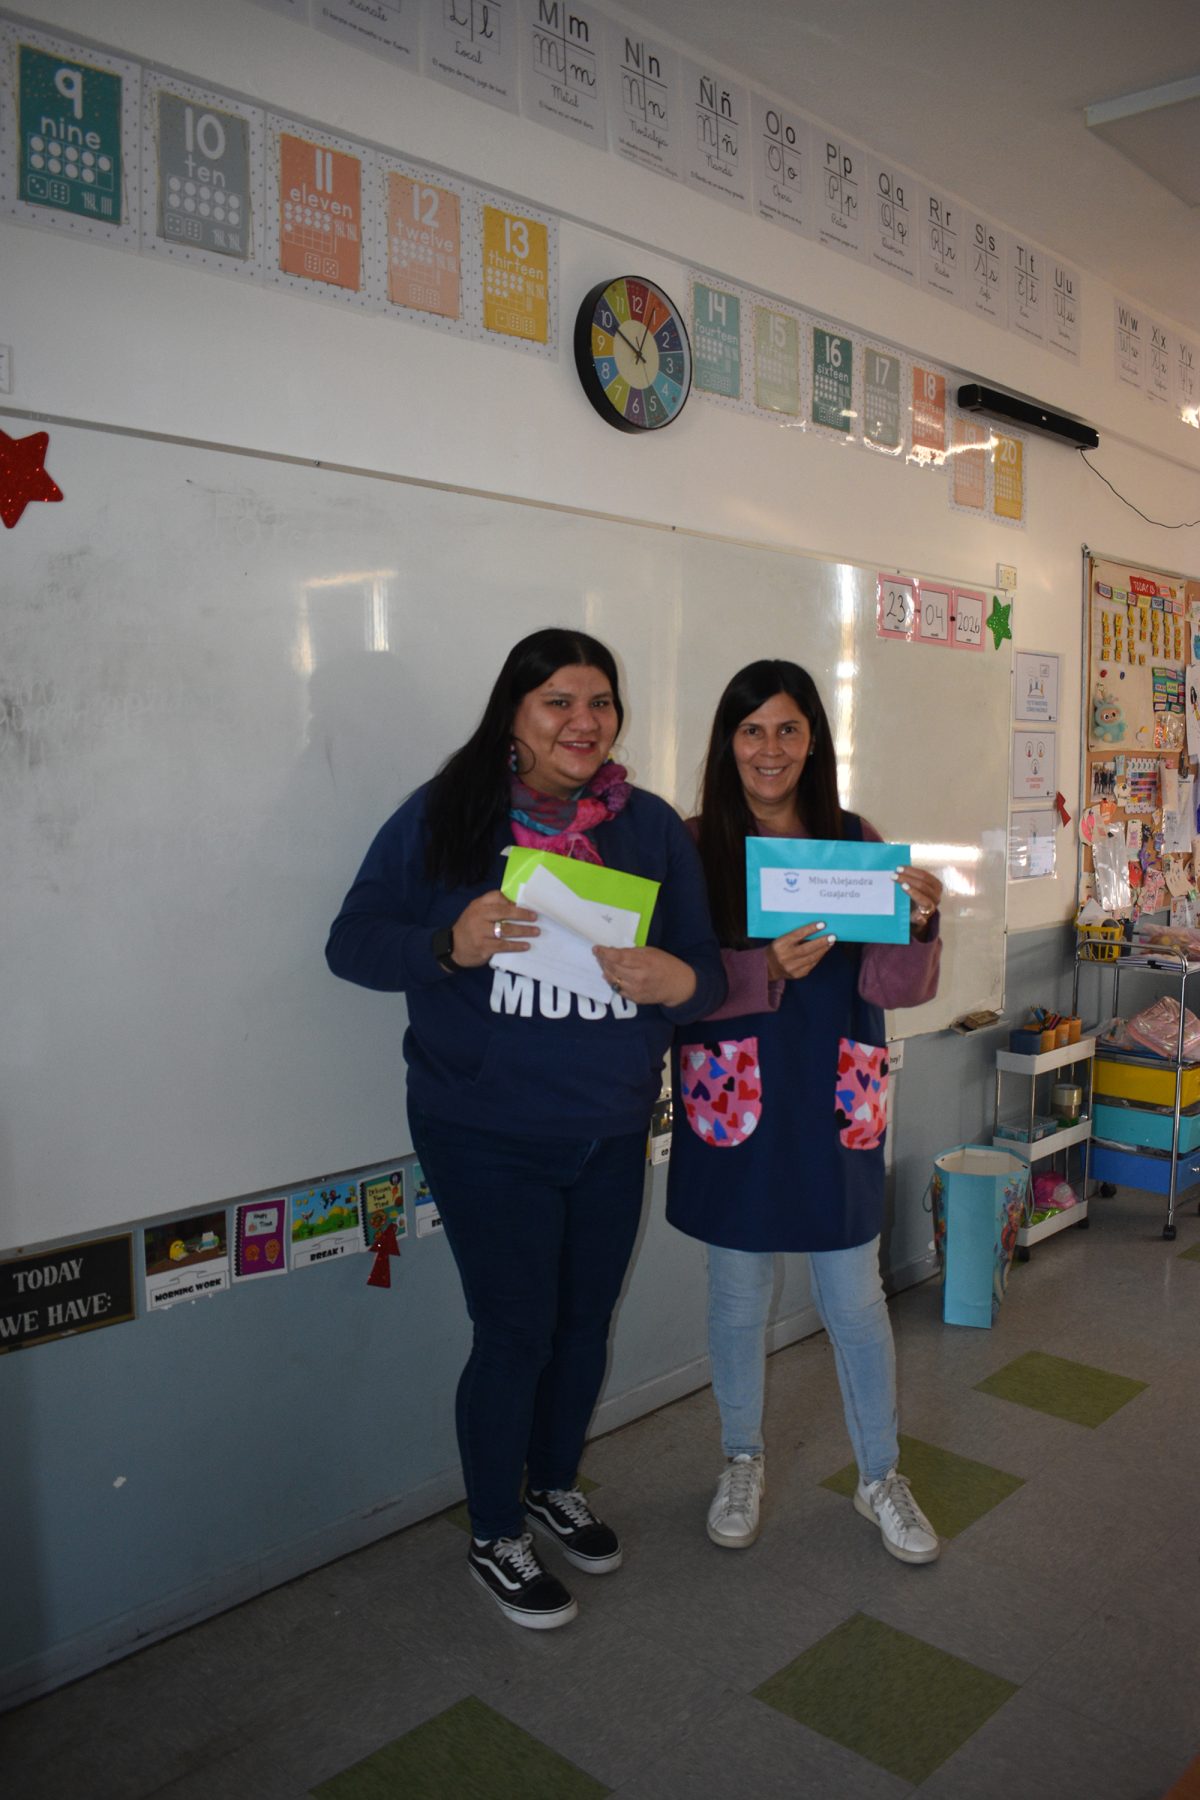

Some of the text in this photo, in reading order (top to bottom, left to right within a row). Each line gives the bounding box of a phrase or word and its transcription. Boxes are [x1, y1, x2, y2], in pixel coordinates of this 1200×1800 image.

[538, 0, 589, 42] M m
[625, 36, 660, 78] N n
[570, 64, 596, 87] m
[54, 66, 84, 120] 9
[551, 84, 580, 108] Metal
[699, 75, 732, 118] Ñ ñ
[648, 100, 666, 120] n
[40, 116, 102, 150] nine
[184, 106, 226, 160] 10
[766, 110, 796, 144] O o
[184, 154, 226, 188] ten
[314, 148, 333, 194] 11
[826, 142, 853, 178] P p
[290, 182, 354, 219] eleven
[879, 172, 904, 208] Q q
[412, 183, 440, 230] 12
[930, 197, 952, 226] R r
[395, 220, 455, 252] twelve
[503, 218, 530, 260] 13
[976, 224, 996, 252] S s
[488, 249, 545, 282] thirteen
[1016, 246, 1035, 273] T t
[1056, 268, 1072, 294] U u
[616, 295, 626, 314] 11
[632, 296, 644, 314] 12
[707, 290, 728, 327] 14
[600, 310, 613, 329] 10
[694, 317, 739, 346] fourteen
[768, 313, 787, 348] 15
[1118, 306, 1138, 332] W w
[597, 336, 606, 352] 9
[662, 333, 670, 350] 2
[1152, 326, 1160, 344] X
[825, 336, 843, 368] 16
[600, 362, 611, 380] 8
[666, 359, 674, 375] 3
[816, 364, 850, 384] sixteen
[874, 356, 891, 386] 17
[614, 385, 622, 401] 7
[660, 383, 669, 397] 4
[923, 372, 937, 401] 18
[632, 397, 640, 414] 6
[648, 396, 658, 412] 5
[1000, 438, 1018, 465] 20
[886, 591, 906, 624] 23
[925, 604, 944, 632] 04
[808, 875, 873, 888] Miss Alejandra
[820, 889, 861, 900] Guajardo
[310, 1248, 339, 1262] BREAK
[12, 1258, 84, 1294] TODAY
[154, 1278, 222, 1303] MORNING WORK
[0, 1292, 112, 1338] WE HAVE:
